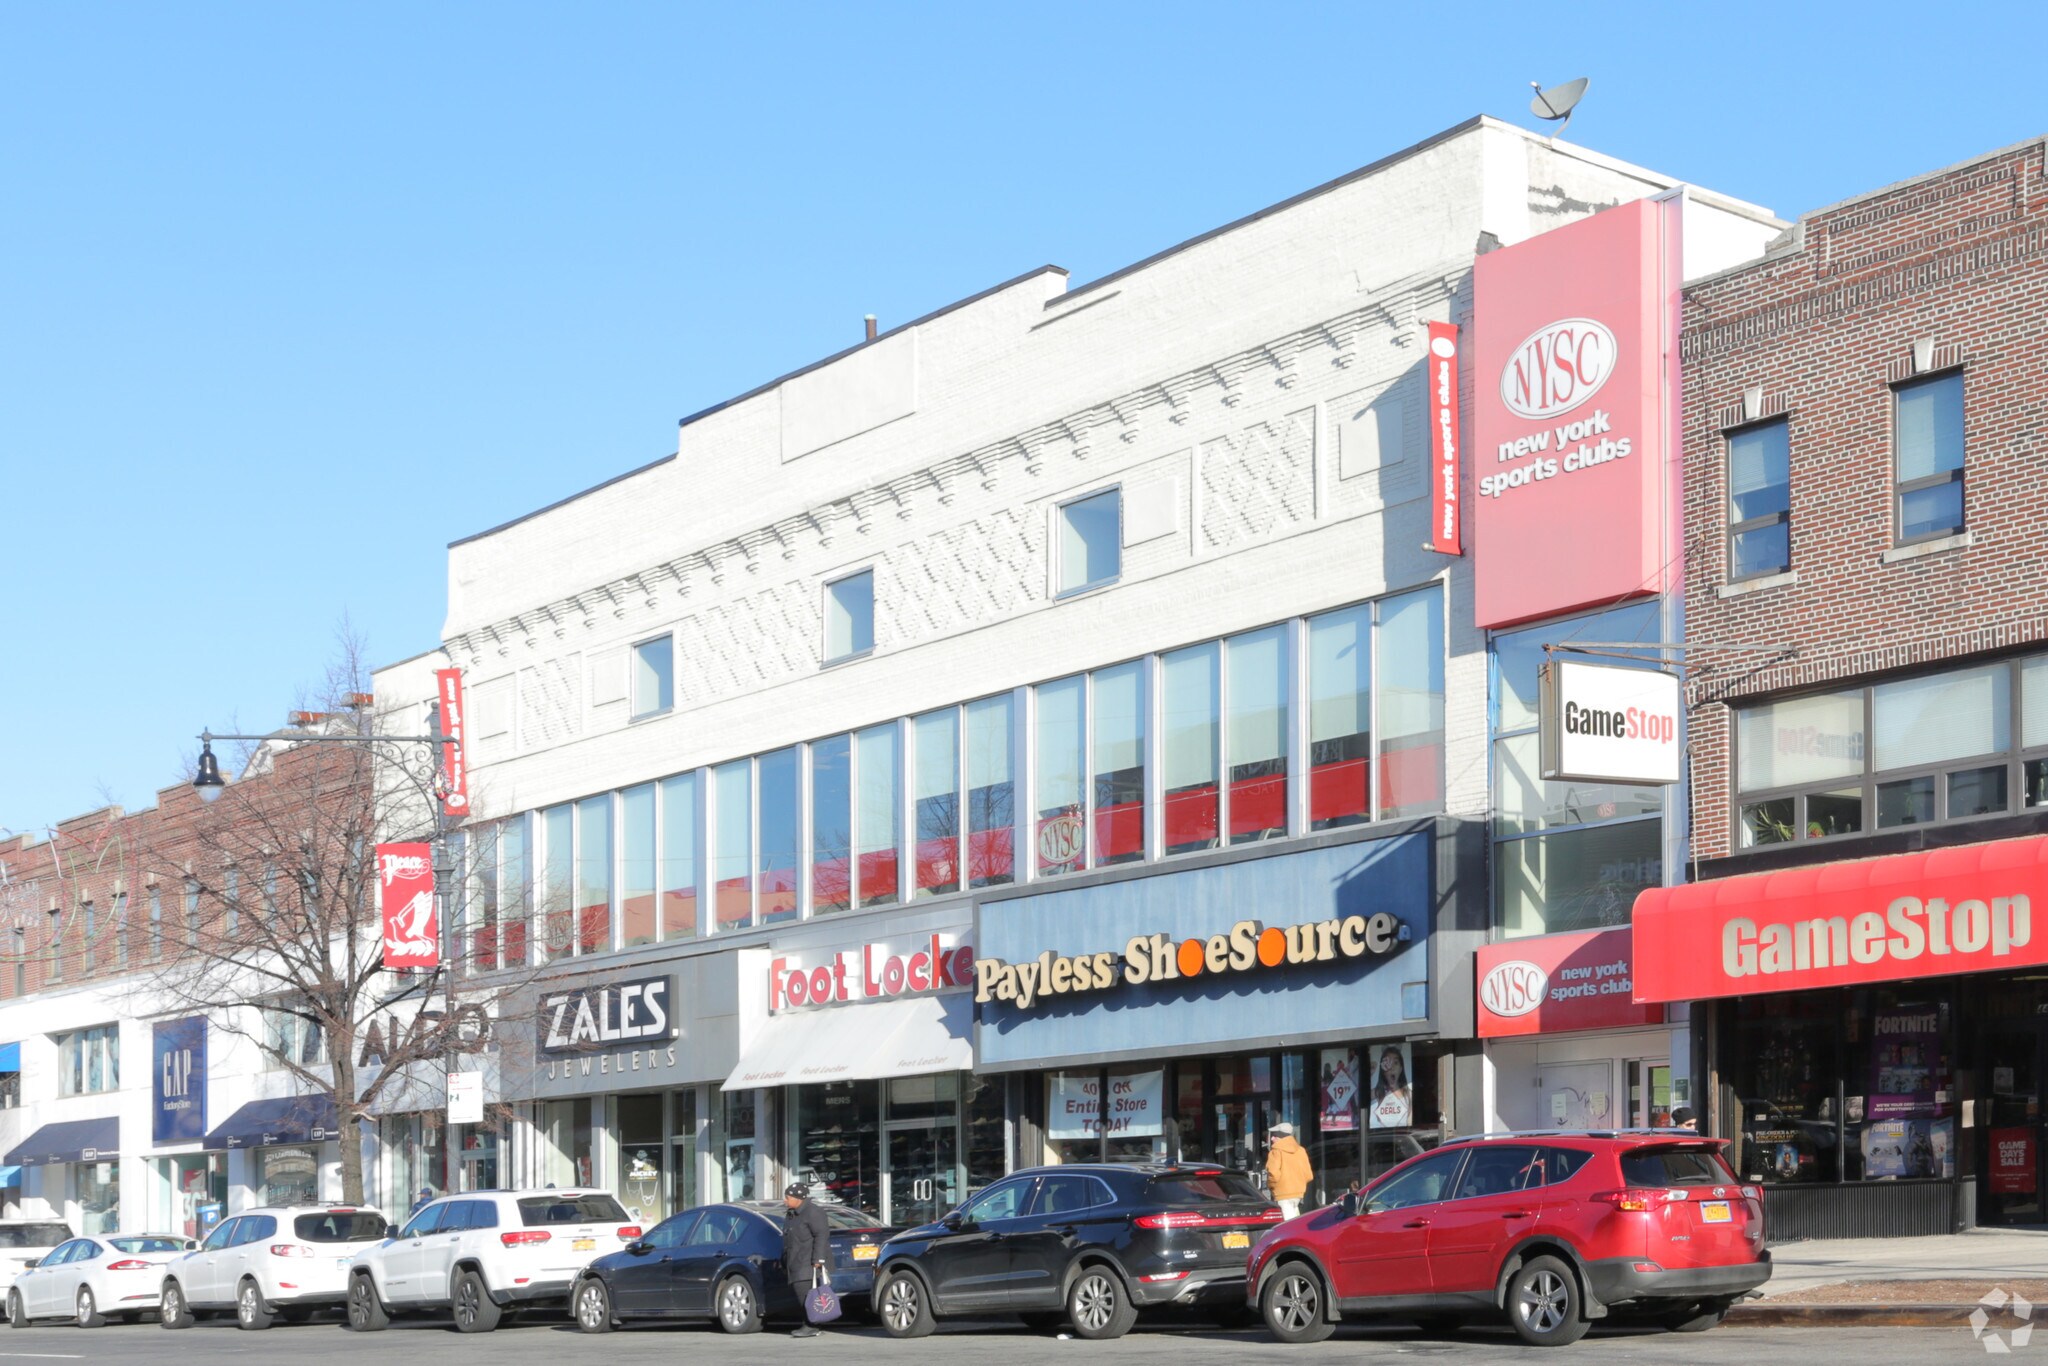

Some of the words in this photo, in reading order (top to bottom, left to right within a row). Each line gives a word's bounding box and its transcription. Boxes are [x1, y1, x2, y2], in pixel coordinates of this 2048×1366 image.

[1438, 361, 1450, 406] clubs
[1513, 328, 1600, 410] NYSC
[1440, 408, 1455, 461] sports
[1498, 429, 1550, 463] new
[1555, 408, 1611, 451] york
[1442, 464, 1456, 501] york
[1479, 456, 1558, 498] sports
[1563, 436, 1632, 474] clubs
[1443, 503, 1454, 540] new
[1565, 700, 1673, 744] GameStop
[1043, 821, 1081, 859] NYSC
[1722, 893, 2031, 978] GameStop
[975, 949, 1119, 1009] Payless
[1124, 912, 1400, 985] ShoeSource
[1561, 966, 1592, 981] new
[1595, 960, 1628, 980] york
[769, 950, 850, 1011] Foot
[1489, 966, 1539, 1011] NYSC
[1551, 982, 1597, 1002] sports
[544, 981, 667, 1049] ZALES
[1874, 1012, 1937, 1036] FORTNITE
[163, 1048, 191, 1098] GAP
[548, 1047, 676, 1082] JEWELERS
[1115, 1097, 1148, 1113] Store
[1082, 1117, 1131, 1133] TODAY
[1871, 1122, 1904, 1133] FORTNITE
[1998, 1140, 2027, 1149] GAME
[2000, 1149, 2025, 1157] DAYS
[2000, 1157, 2025, 1166] SALE
[207, 1212, 215, 1222] P
